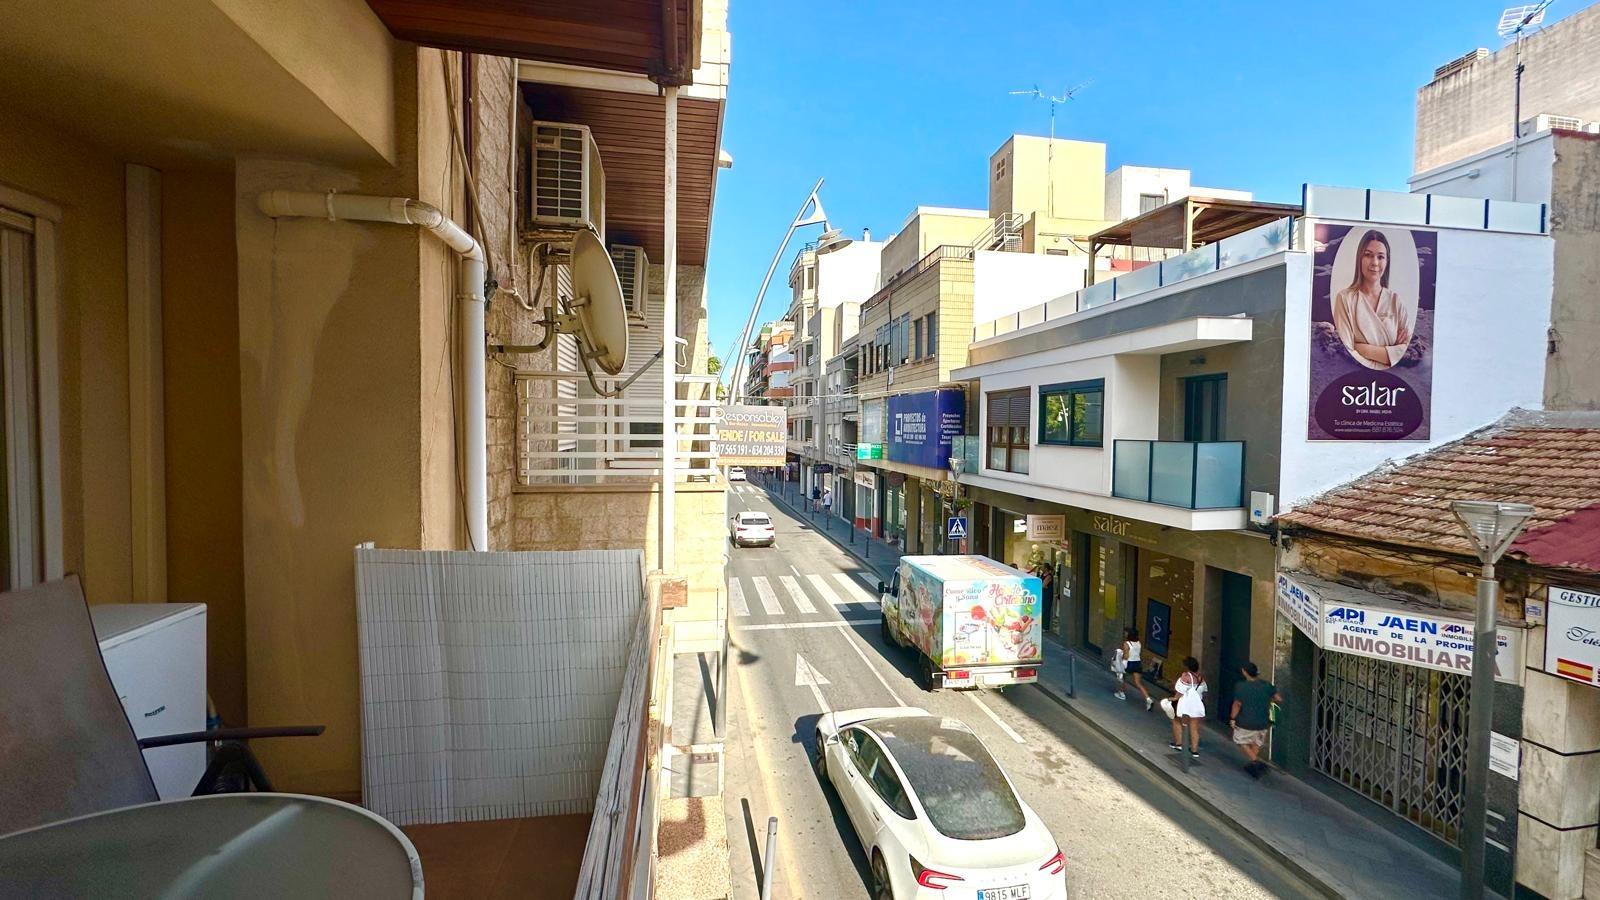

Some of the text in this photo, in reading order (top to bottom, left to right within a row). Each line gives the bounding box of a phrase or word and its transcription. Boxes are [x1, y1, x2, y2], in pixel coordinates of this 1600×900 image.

[1341, 380, 1406, 406] salar
[748, 430, 765, 442] FOR
[766, 431, 785, 443] SALE
[725, 444, 737, 455] 565
[737, 444, 748, 455] 191
[1093, 515, 1131, 536] salar
[1278, 594, 1319, 642] INMOBILIARIA
[1328, 607, 1365, 623] API
[1377, 615, 1438, 635] JAEN
[1342, 624, 1475, 652] AGENTE DE LA PROPIE
[1445, 625, 1465, 634] API
[1566, 626, 1600, 647] Telé
[1332, 632, 1502, 677] INMOBILIAR
[985, 886, 1027, 900] 9815 MLF
